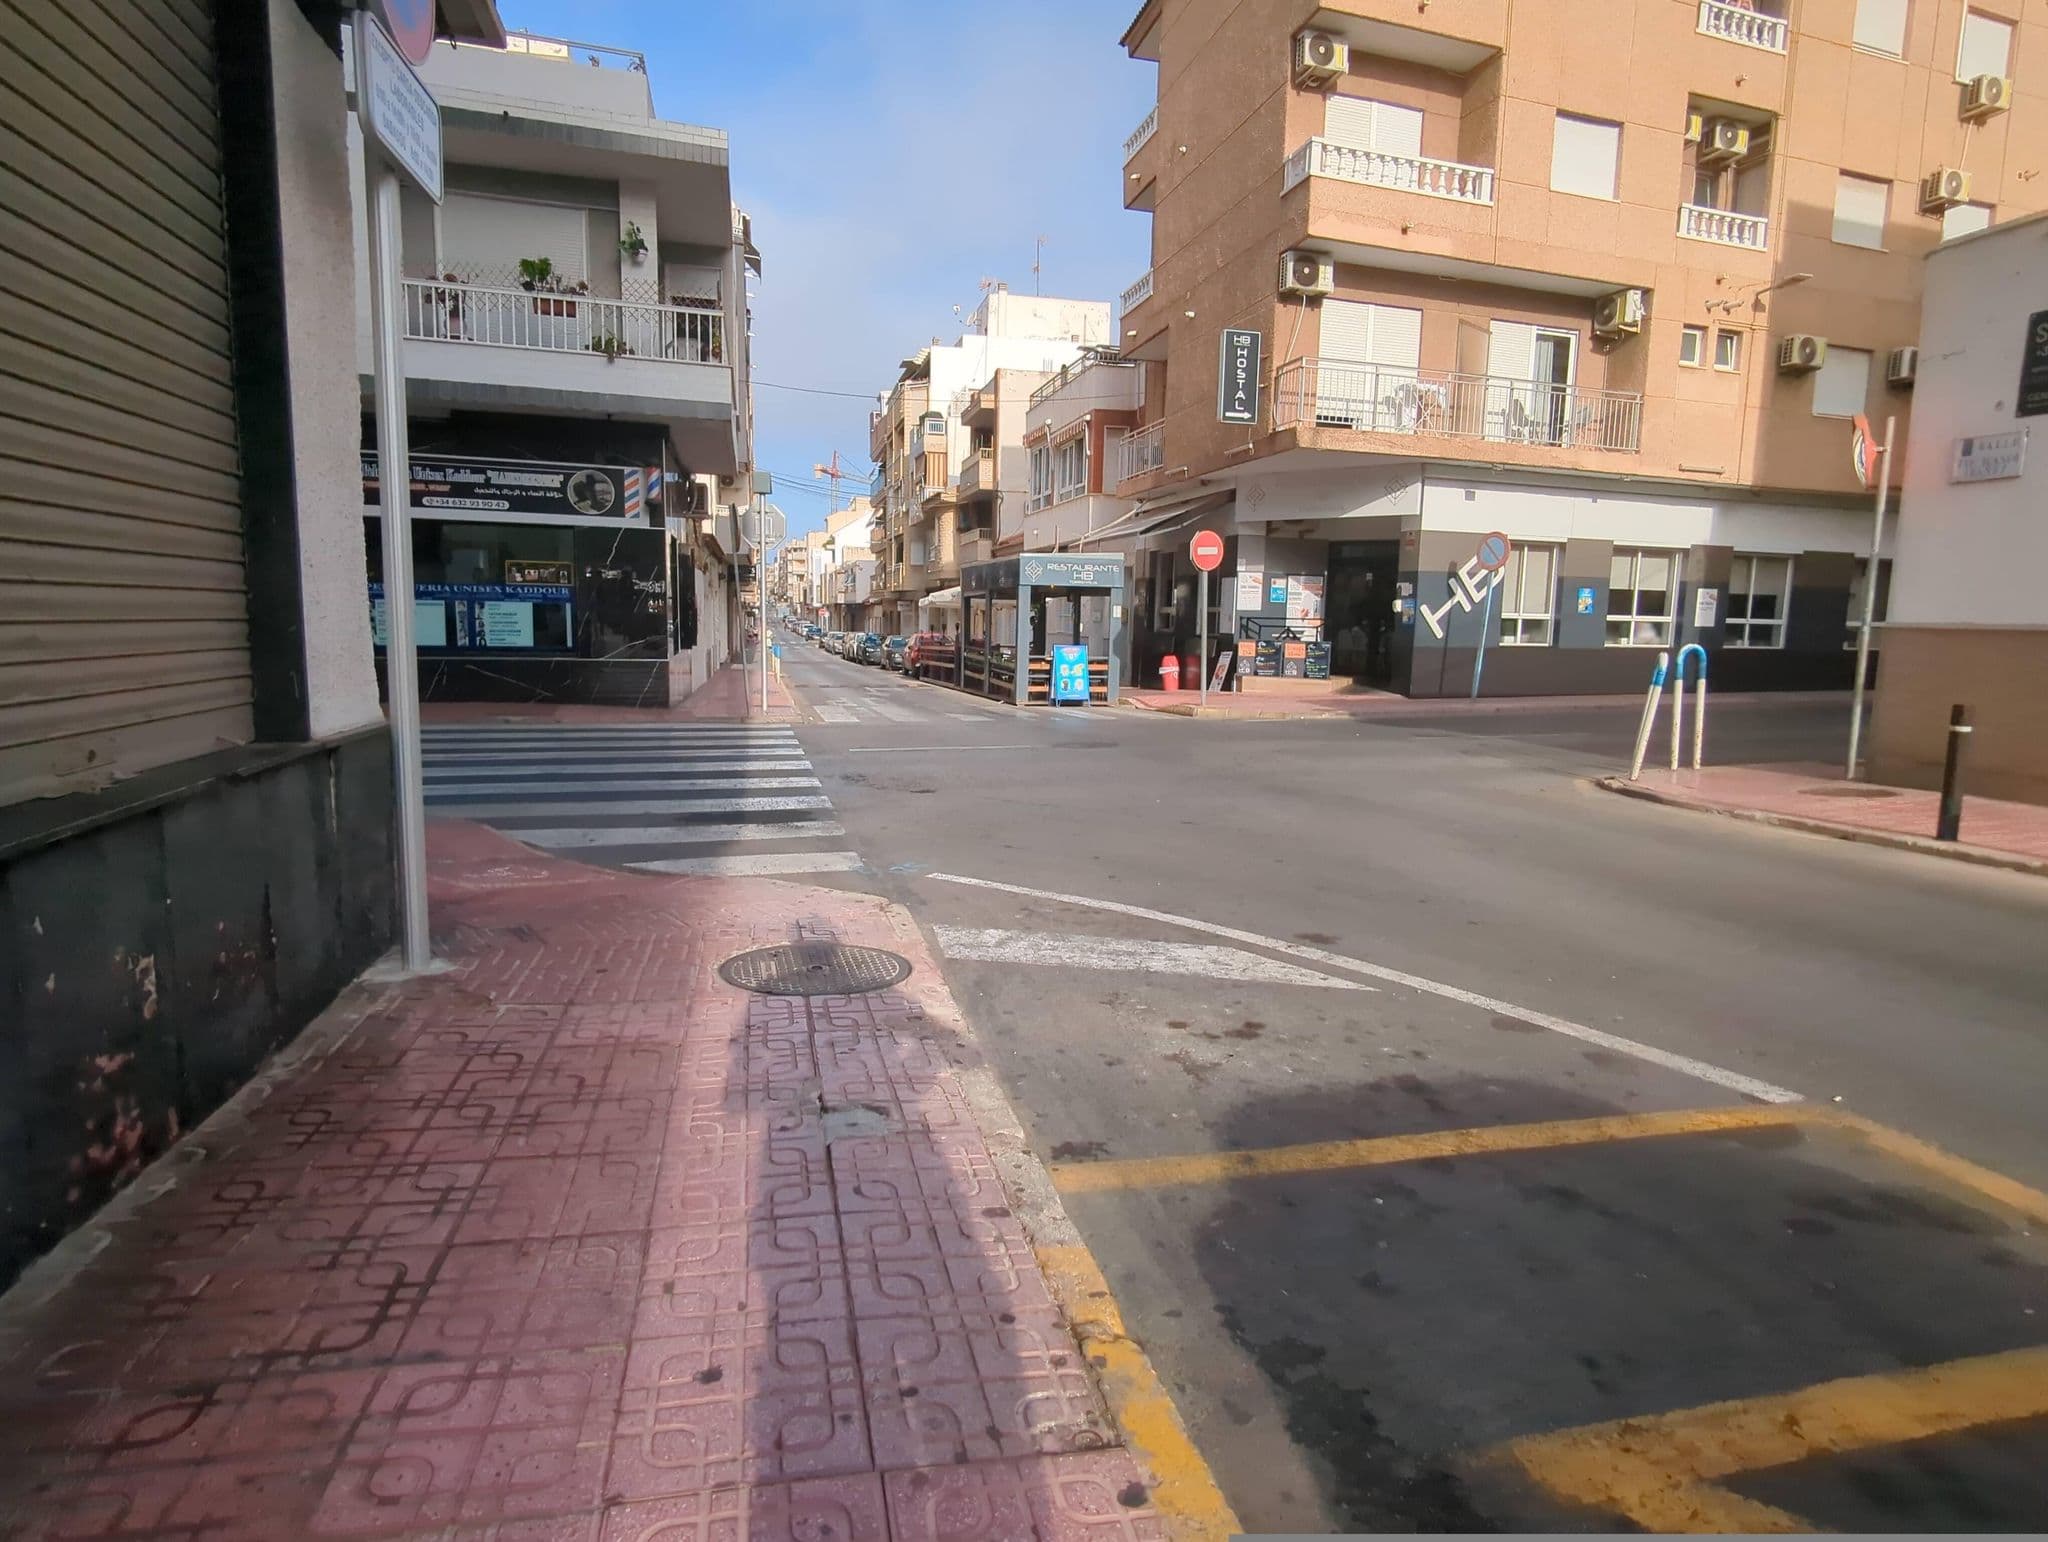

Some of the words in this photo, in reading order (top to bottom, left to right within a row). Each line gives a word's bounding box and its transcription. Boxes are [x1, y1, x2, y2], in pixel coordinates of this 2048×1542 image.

[1234, 335, 1250, 344] HB
[1234, 347, 1248, 411] HOSTAL
[1047, 563, 1120, 573] RESTAURANTE
[1073, 571, 1094, 581] HB
[453, 584, 503, 593] UNISEX
[505, 586, 569, 595] KADDOUR
